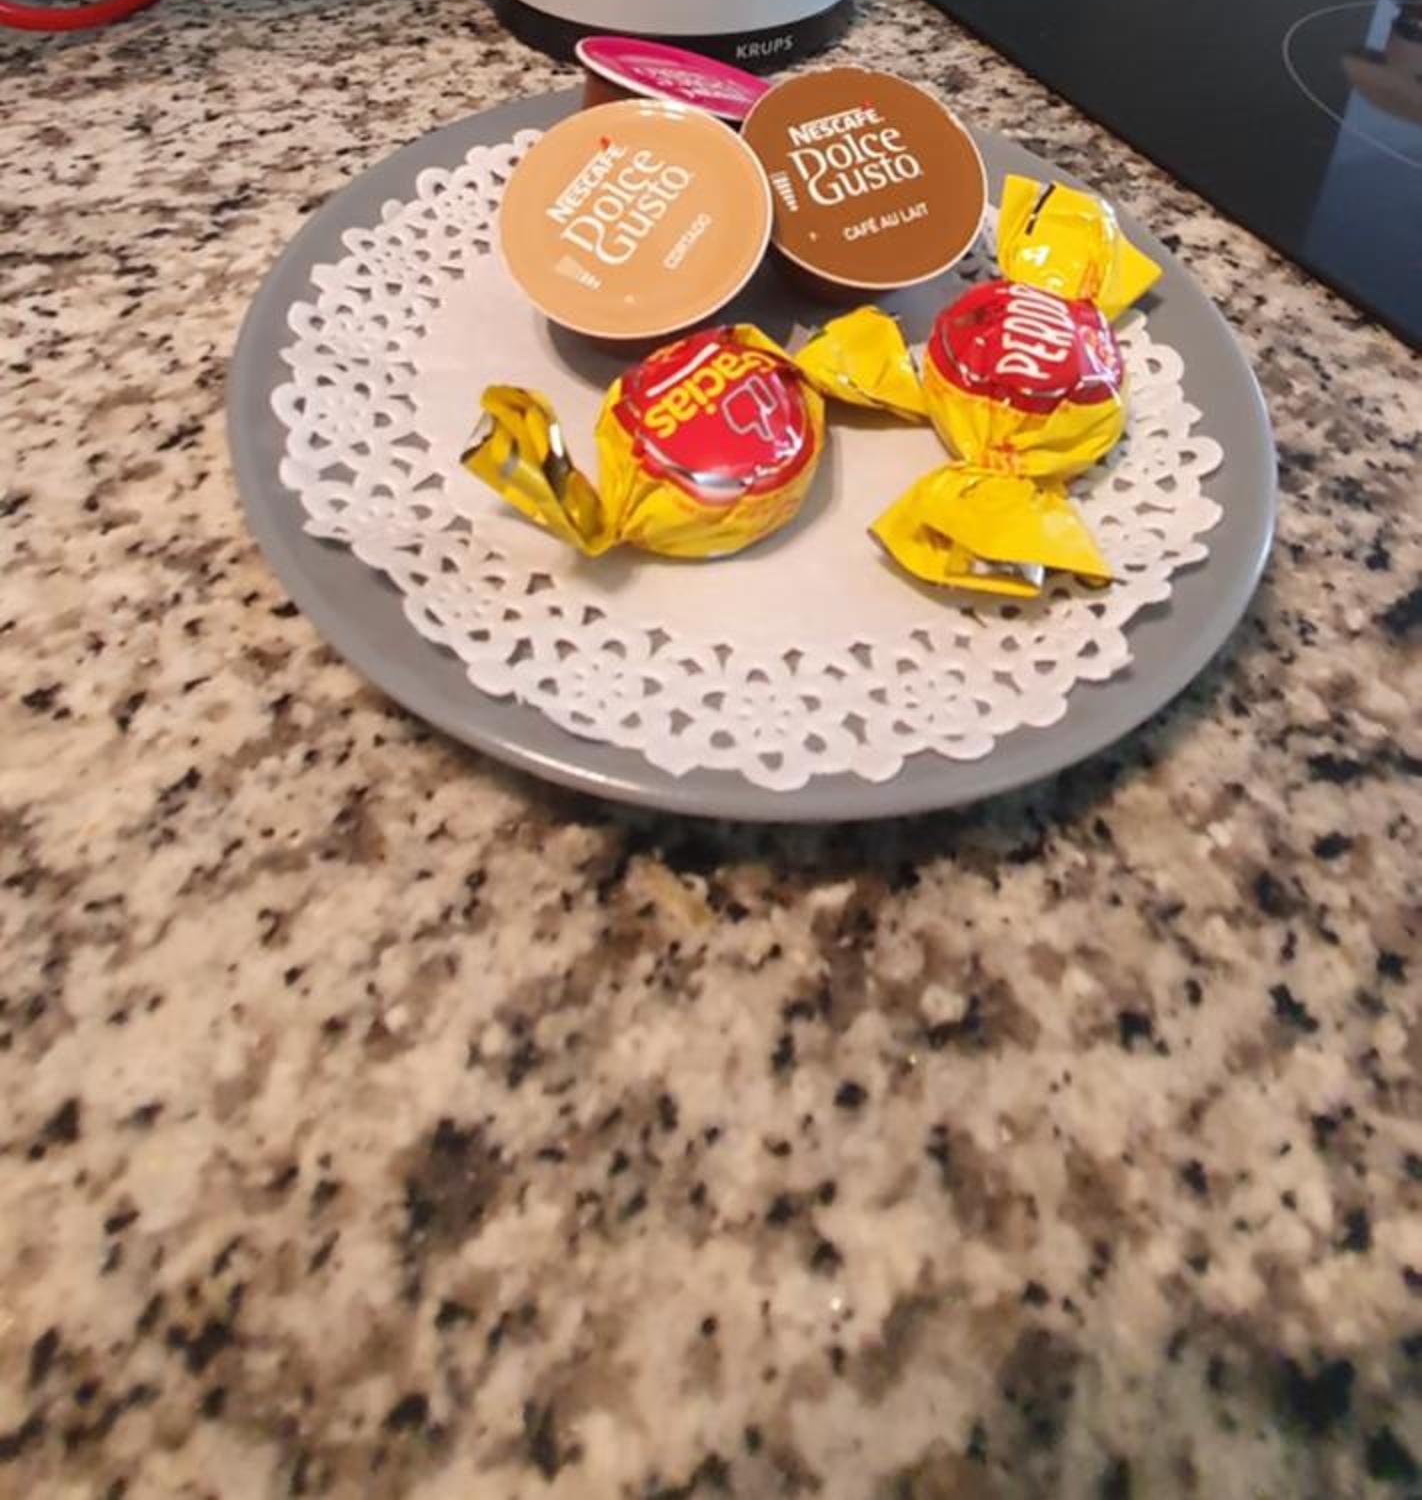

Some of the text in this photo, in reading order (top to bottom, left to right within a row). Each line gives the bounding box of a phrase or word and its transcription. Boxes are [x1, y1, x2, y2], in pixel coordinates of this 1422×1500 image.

[736, 34, 794, 59] KRUPS
[786, 127, 907, 182] Dolce
[807, 153, 921, 206] Gusto
[560, 149, 667, 252] Dolce
[595, 165, 692, 265] Gusto
[879, 211, 900, 230] AU
[899, 201, 930, 223] LAIT
[662, 212, 713, 271] CORTADO
